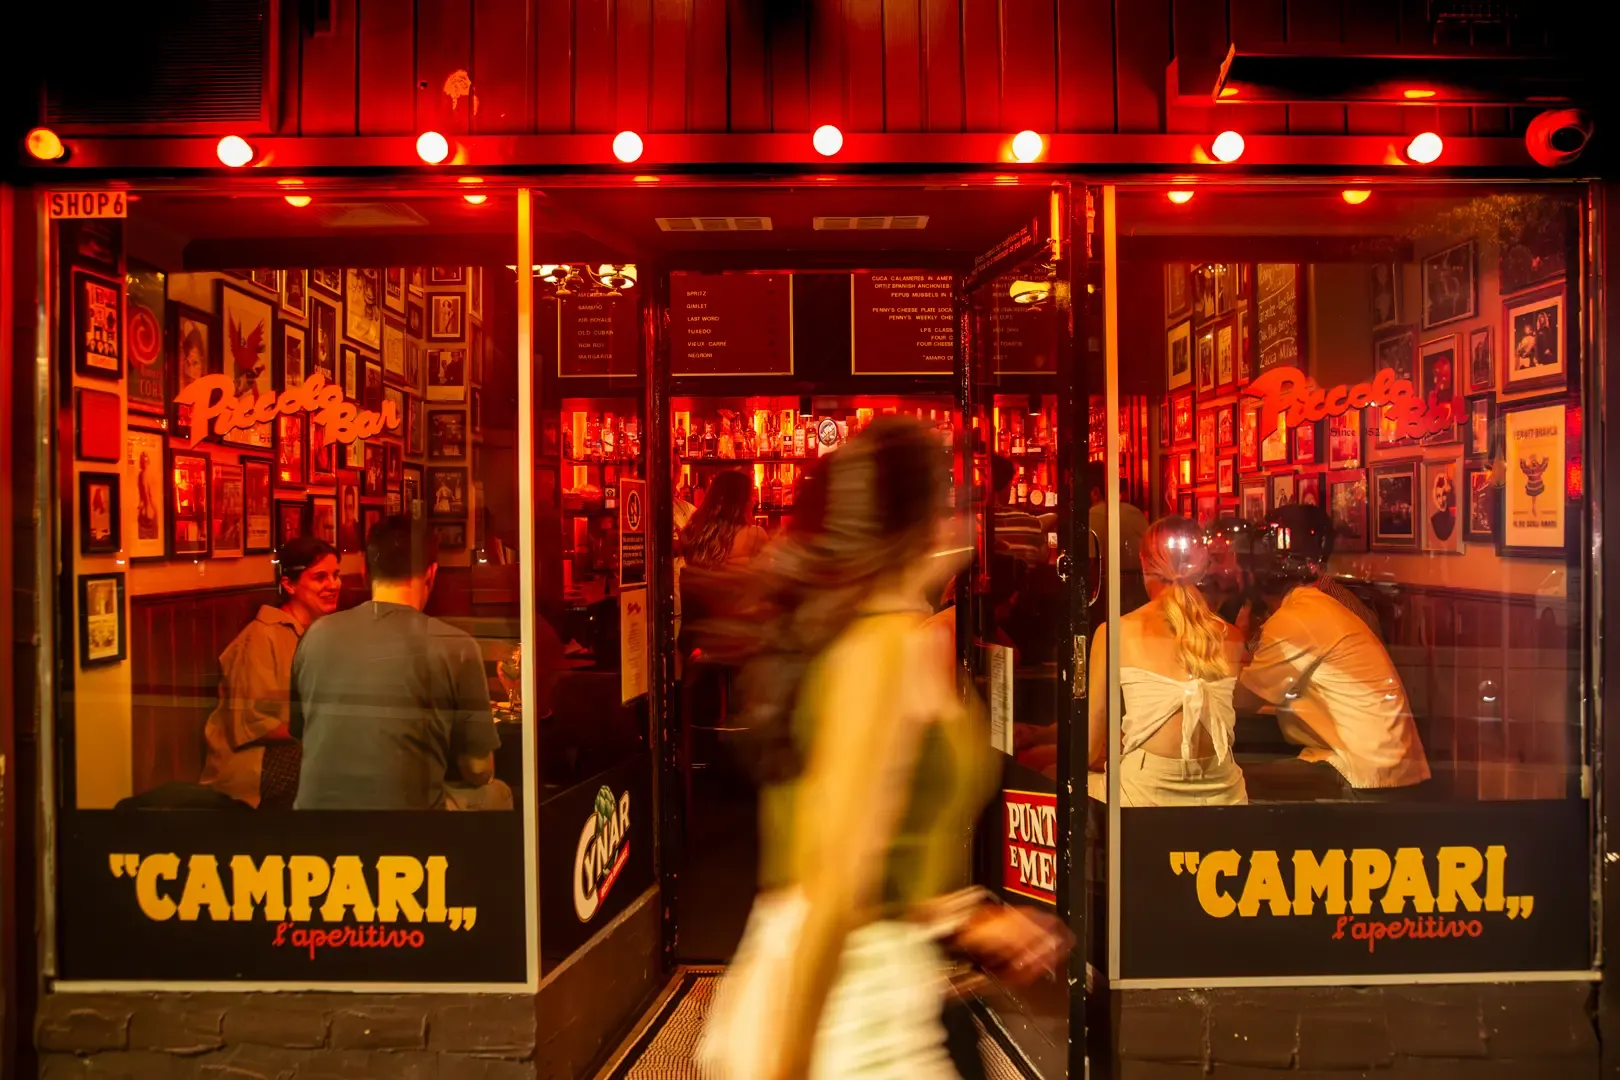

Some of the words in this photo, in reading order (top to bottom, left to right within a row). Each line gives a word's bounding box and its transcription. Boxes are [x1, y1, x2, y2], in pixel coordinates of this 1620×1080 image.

[52, 193, 109, 216] SHOP
[114, 193, 124, 215] 6
[173, 373, 344, 449] Piccolo
[312, 399, 401, 447] Bar
[1242, 366, 1415, 442] Piccolo
[1384, 396, 1471, 440] Bar
[1330, 427, 1356, 438] Since
[1006, 801, 1057, 848] PUNT
[573, 790, 631, 923] CYNAR
[272, 922, 425, 960] l'aperitivo
[1332, 916, 1483, 953] l'aperitivo
